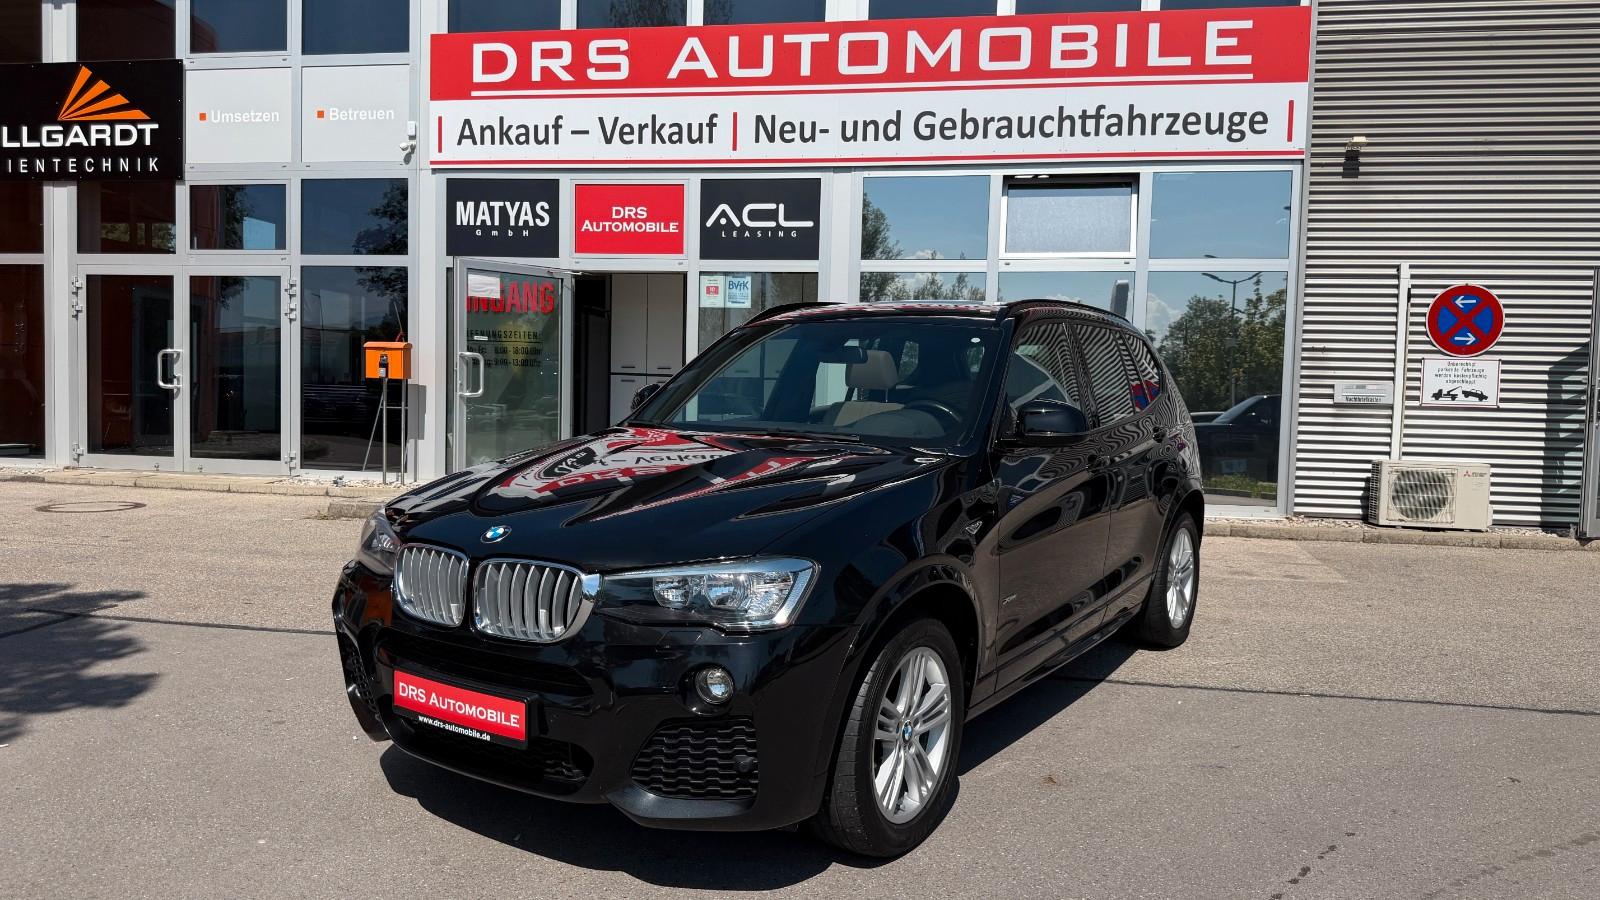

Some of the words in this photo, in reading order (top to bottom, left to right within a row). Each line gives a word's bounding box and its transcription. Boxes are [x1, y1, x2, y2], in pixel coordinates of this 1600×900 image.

[472, 38, 630, 83] DRS
[666, 19, 1254, 80] AUTOMOBILE
[210, 109, 280, 123] Umsetzen
[329, 107, 395, 121] Betreuen
[456, 114, 564, 146] Ankauf
[598, 113, 719, 145] Verkauf
[754, 114, 830, 144] Neu-
[841, 109, 902, 142] und
[913, 103, 1269, 142] Gebrauchtfahrzeuge
[2, 123, 160, 148] LLGARDT
[8, 157, 159, 173] IENTECHNIK
[456, 201, 550, 227] MATYAS
[612, 206, 648, 219] DRS
[705, 203, 814, 228] ACL
[475, 229, 530, 237] GmbH
[581, 219, 679, 233] AUTOMOBILE
[721, 230, 798, 238] LEASING
[398, 681, 427, 703] DRS
[428, 692, 520, 728] AUTOMOBILE
[418, 715, 491, 741] www.drs-automobile.de
